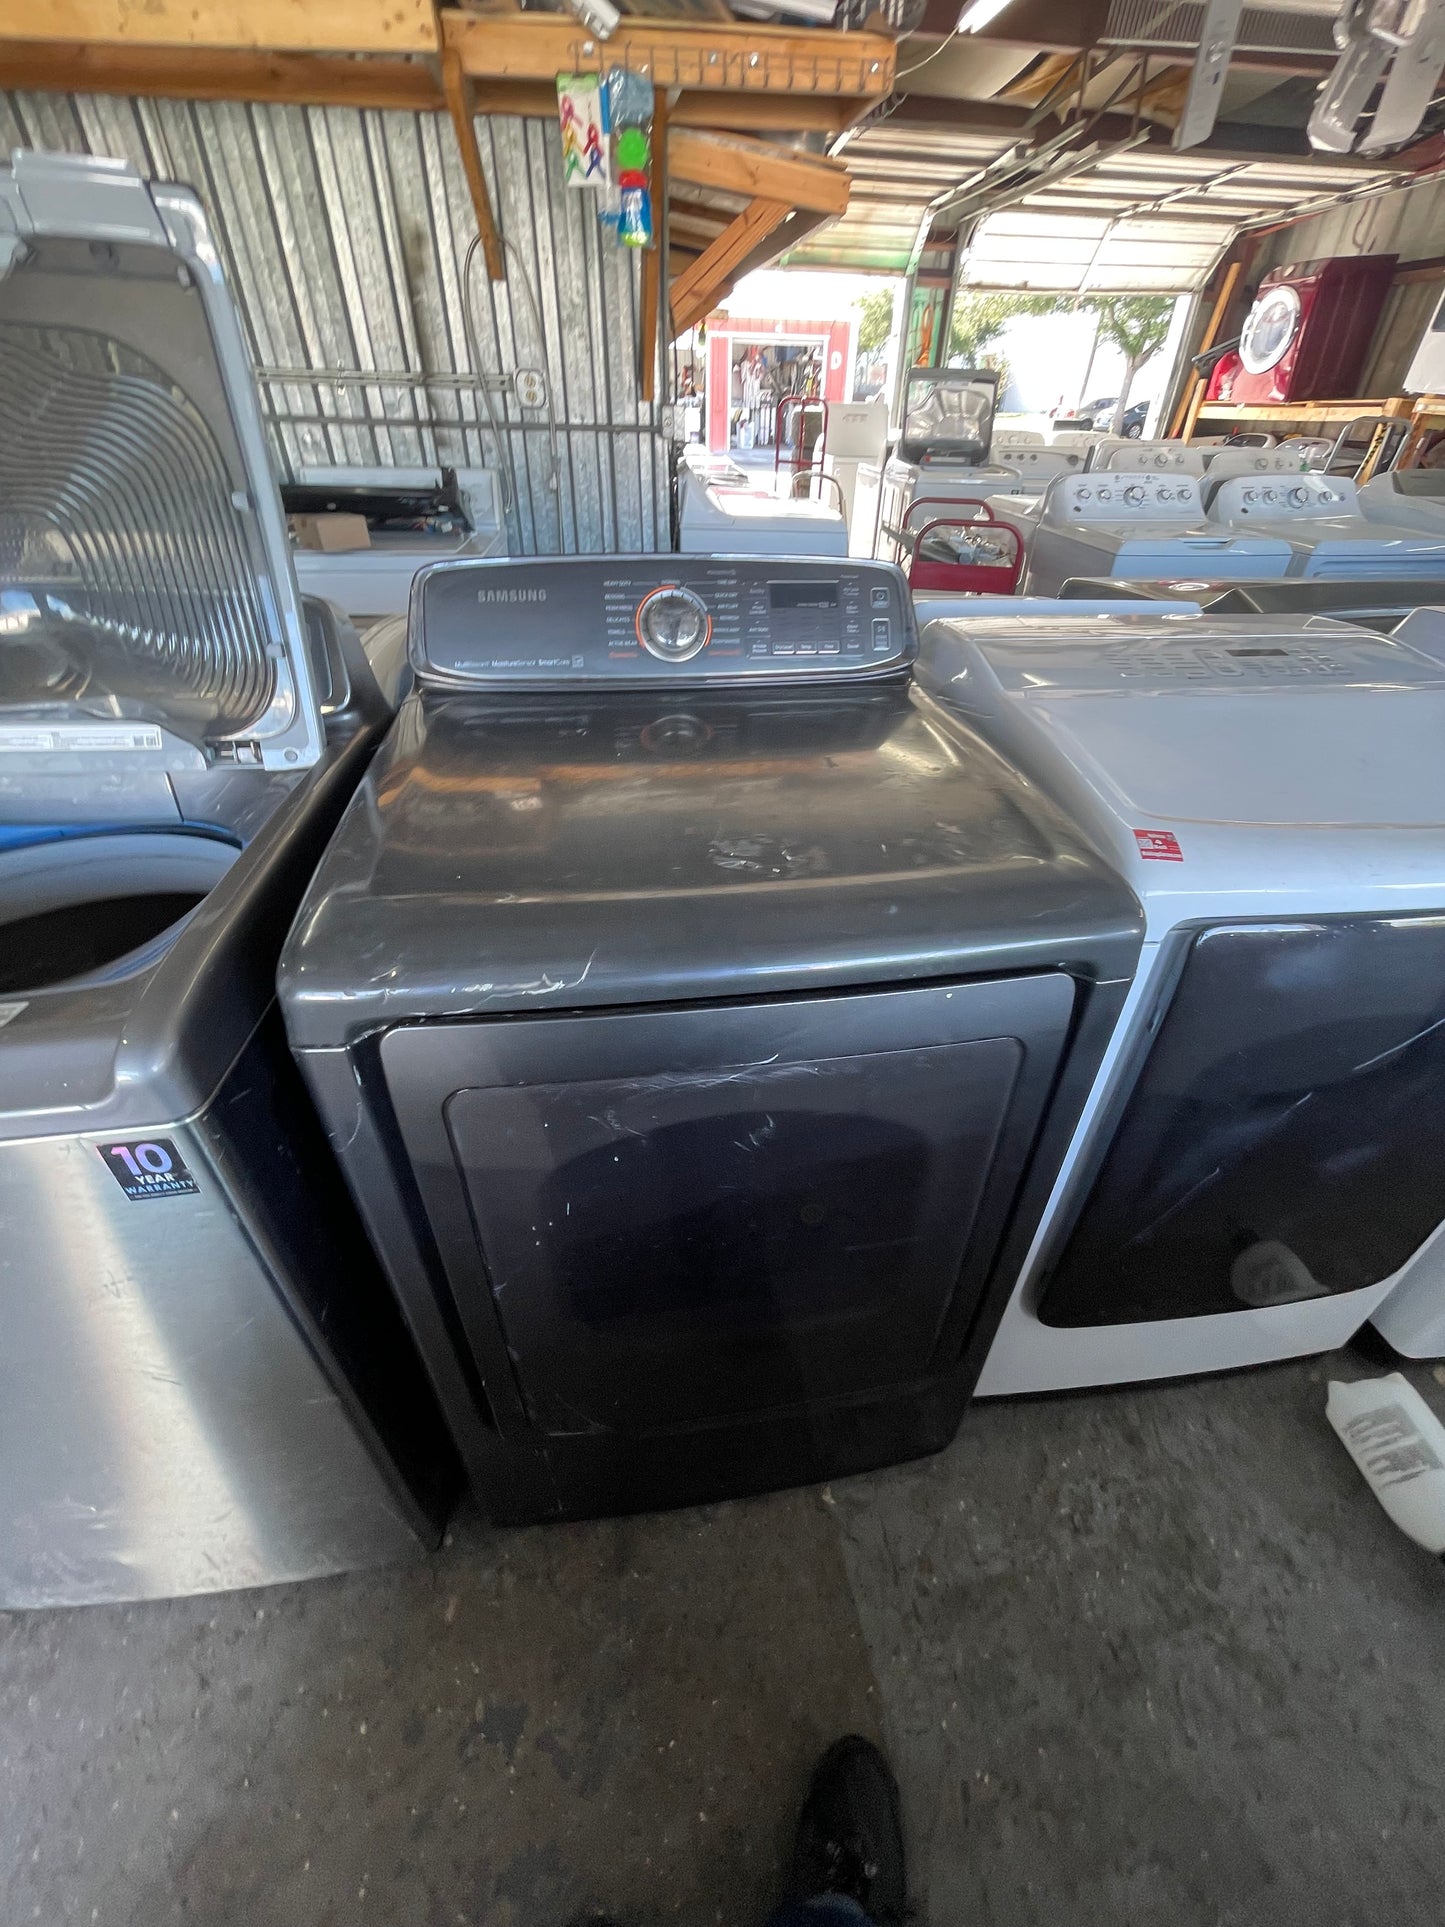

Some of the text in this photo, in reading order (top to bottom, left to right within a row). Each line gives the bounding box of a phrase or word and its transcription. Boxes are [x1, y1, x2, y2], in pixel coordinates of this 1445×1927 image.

[477, 589, 547, 603] SAMSUNG
[111, 1143, 173, 1176] 10
[134, 1173, 175, 1185] YEAR
[124, 1180, 194, 1195] WARRANTY
